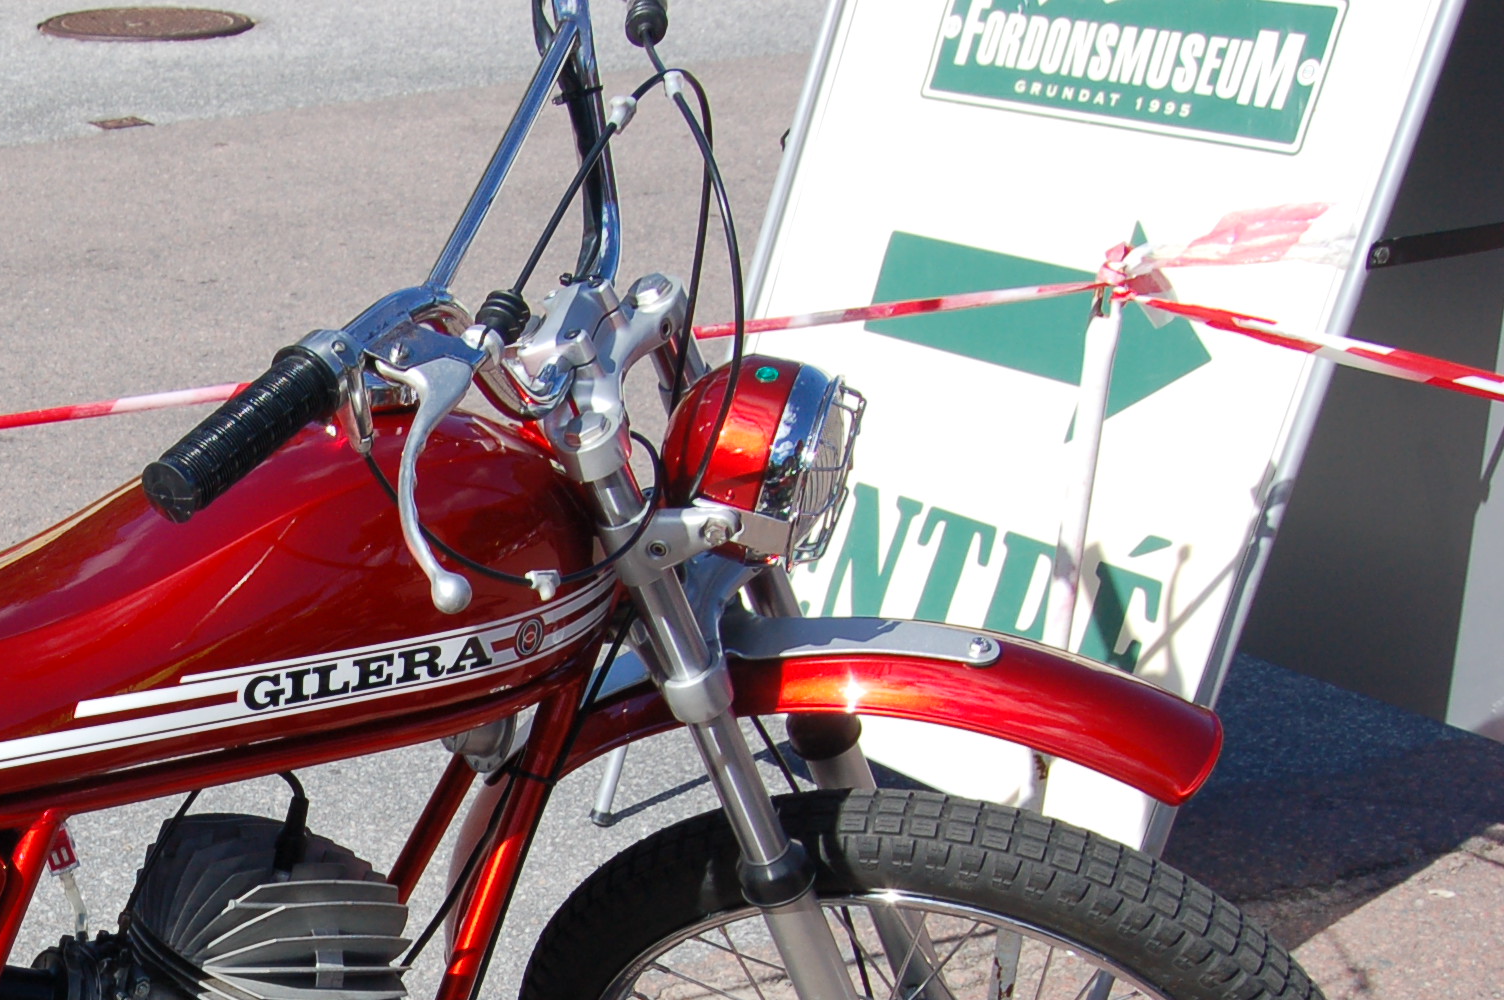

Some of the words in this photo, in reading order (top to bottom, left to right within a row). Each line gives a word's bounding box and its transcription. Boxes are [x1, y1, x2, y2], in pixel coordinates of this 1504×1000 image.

[953, 0, 1306, 111] FORDONSMUSEUM
[1014, 79, 1121, 108] GRUNDAT
[1134, 96, 1193, 118] 1995
[796, 481, 1173, 674] NTÉ
[243, 635, 493, 711] GILERA
